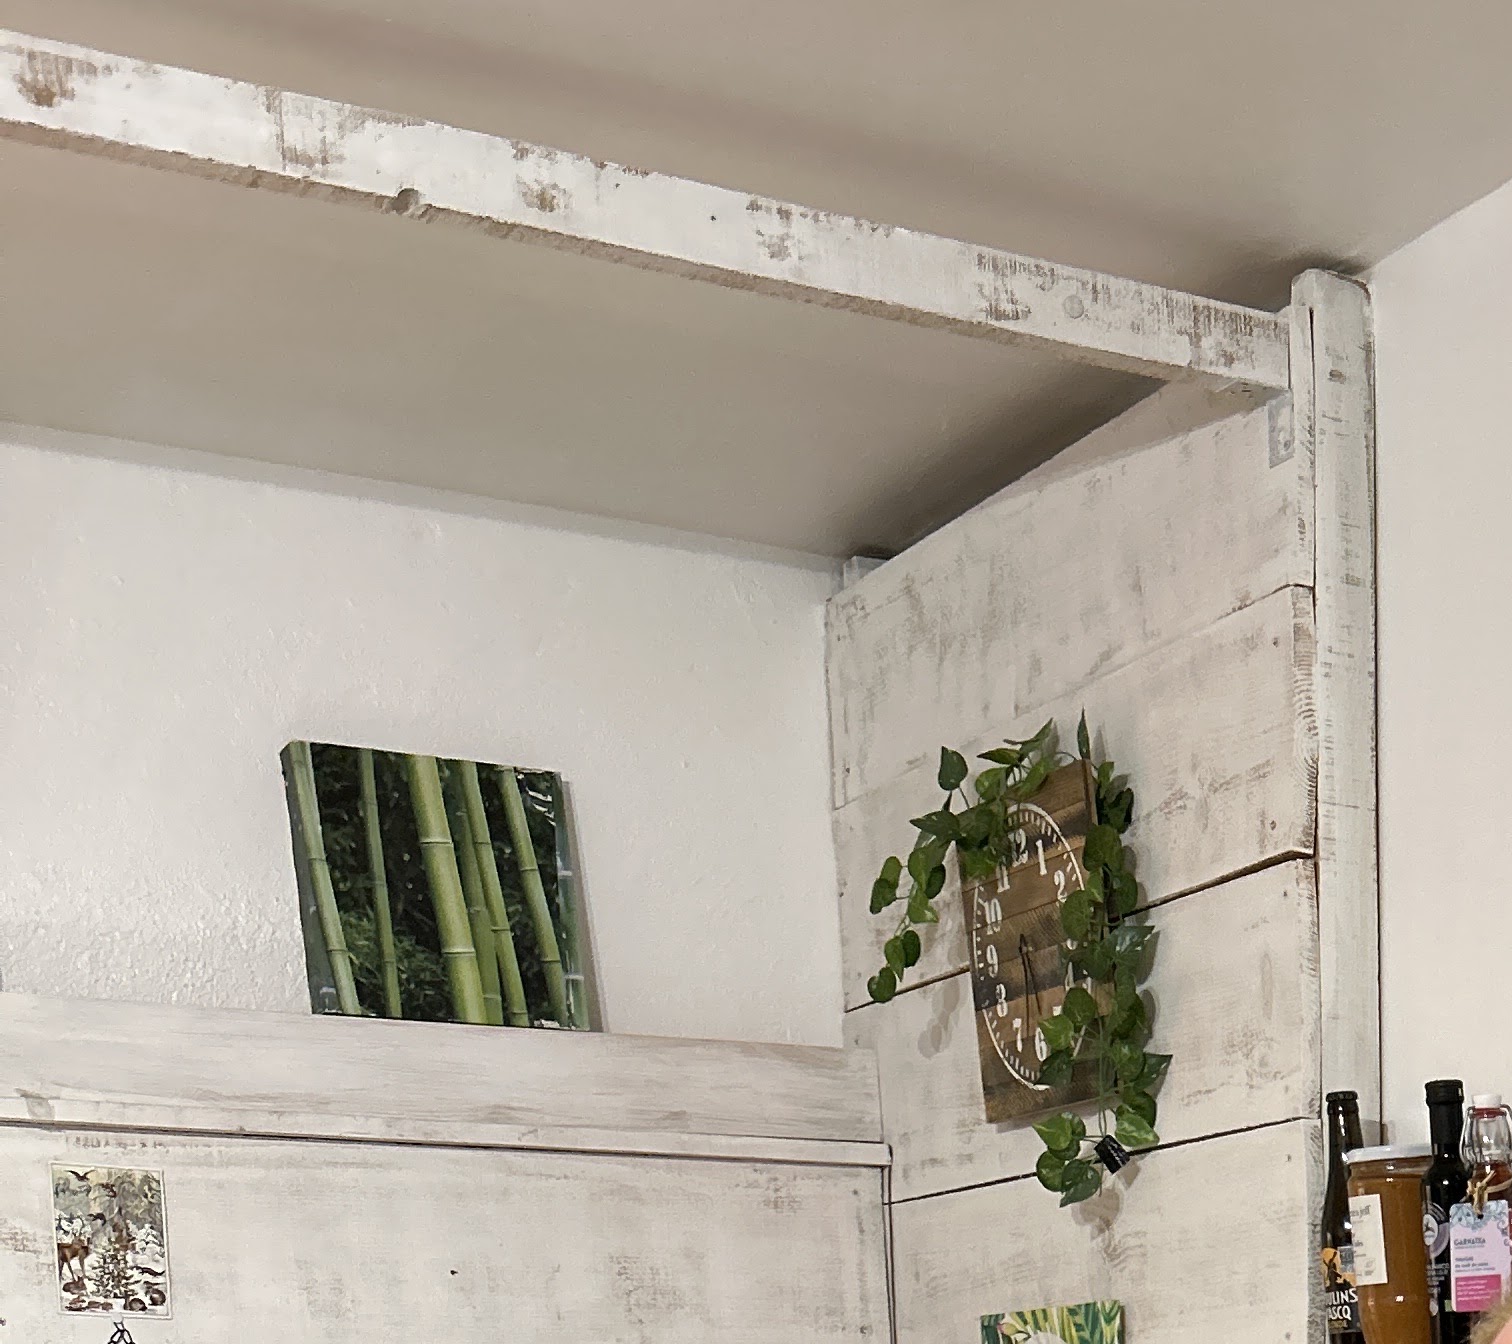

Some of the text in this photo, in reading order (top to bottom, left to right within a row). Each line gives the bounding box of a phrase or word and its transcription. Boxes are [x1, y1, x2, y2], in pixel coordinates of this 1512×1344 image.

[1036, 839, 1047, 876] 1
[1054, 870, 1067, 903] 2
[978, 898, 1002, 935] 10
[986, 945, 998, 978] 9
[996, 983, 1008, 1018] 8
[1013, 1018, 1023, 1053] 7
[1035, 1027, 1048, 1062] 6
